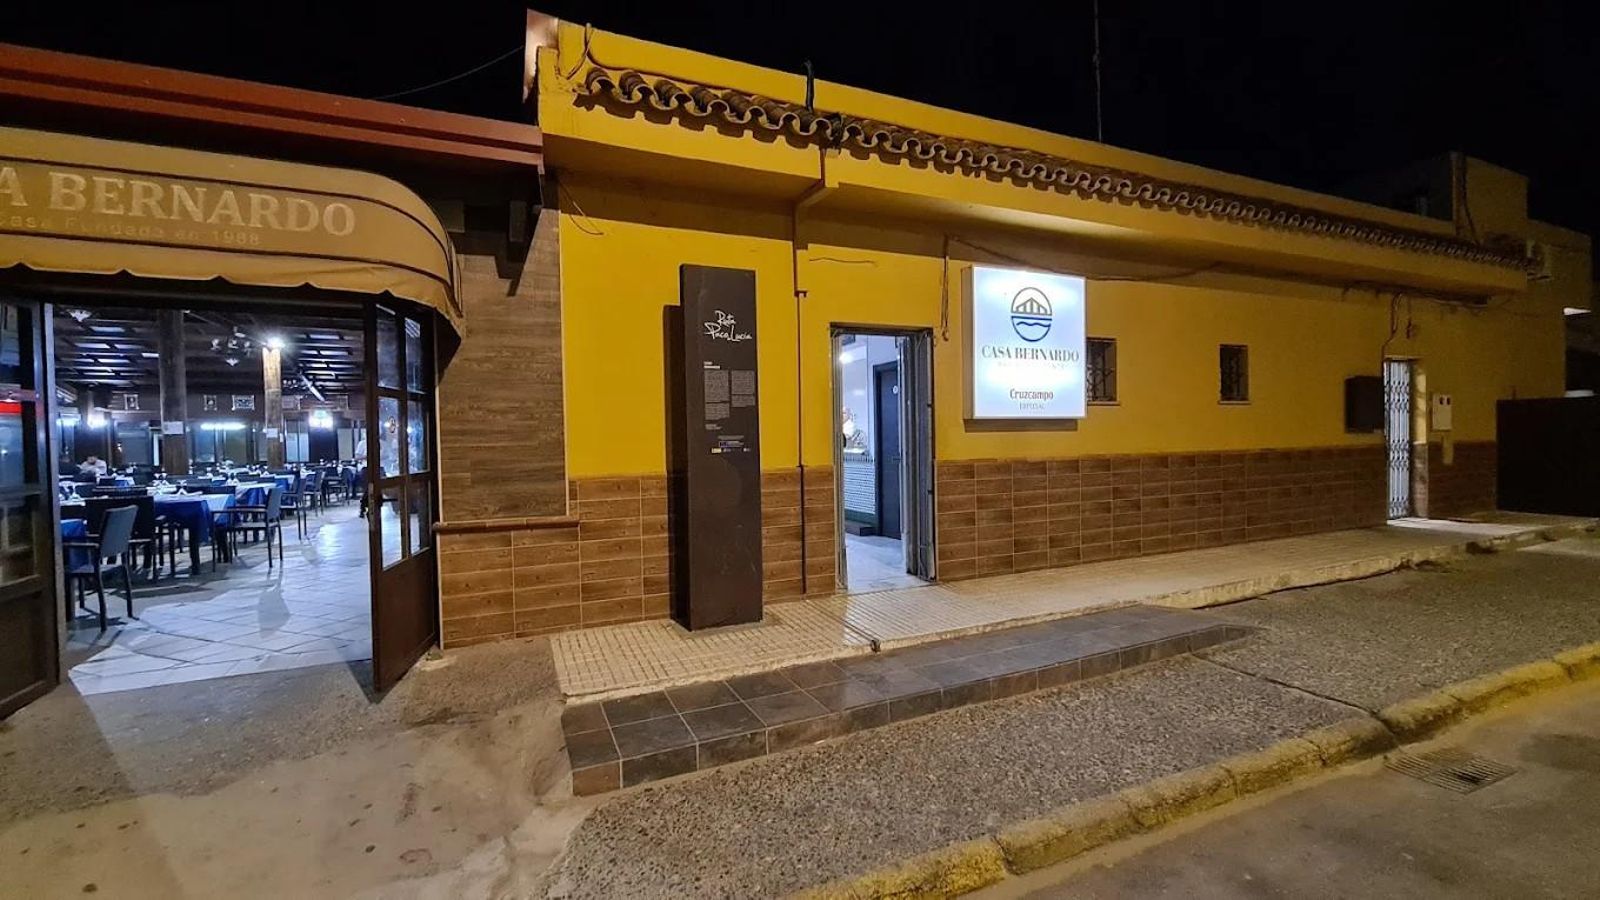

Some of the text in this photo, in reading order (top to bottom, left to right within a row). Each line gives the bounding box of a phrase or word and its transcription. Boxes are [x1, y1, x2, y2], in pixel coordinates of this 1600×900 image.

[0, 166, 356, 236] A BERNARDO
[715, 310, 736, 327] Ruta
[704, 322, 728, 340] Paco
[981, 345, 1079, 361] CASA BERNARDO
[1009, 388, 1054, 401] Cruzcampo
